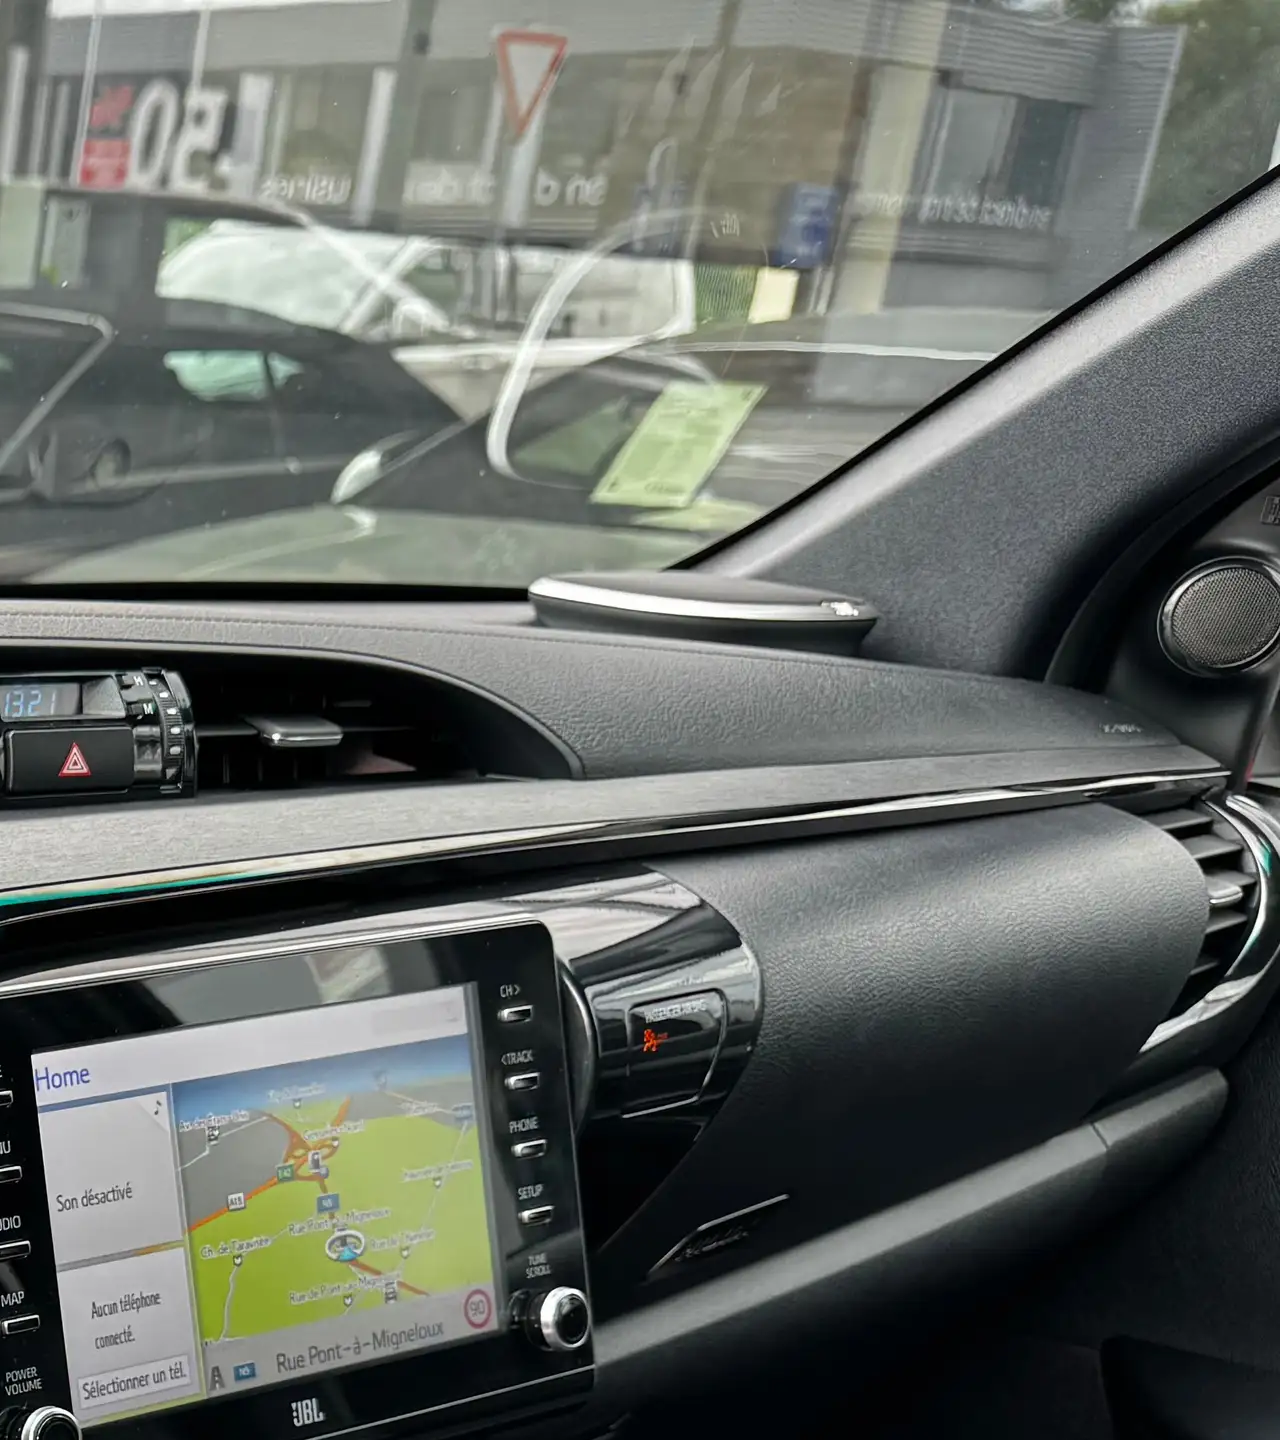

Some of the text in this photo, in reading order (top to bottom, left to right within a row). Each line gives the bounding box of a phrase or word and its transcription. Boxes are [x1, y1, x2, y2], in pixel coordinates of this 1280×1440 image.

[133, 675, 144, 687] H
[143, 702, 154, 715] M
[34, 1066, 91, 1092] Home
[509, 1116, 539, 1134] PHONE
[56, 1182, 133, 1212] Son désactivé
[518, 1184, 544, 1200] SETUP
[528, 1253, 547, 1266] TUNE
[526, 1265, 551, 1279] SCROLL
[0, 1290, 25, 1308] MAP
[91, 1290, 161, 1320] Aucun téléphone
[466, 1299, 487, 1321] 90
[94, 1324, 136, 1350] connecté.
[277, 1320, 444, 1375] Rue Pont-à-Migneloux
[5, 1365, 38, 1384] POWER
[82, 1360, 188, 1398] Sélectionner un tél.
[4, 1377, 42, 1396] VOLUME
[291, 1397, 325, 1427] JBL
